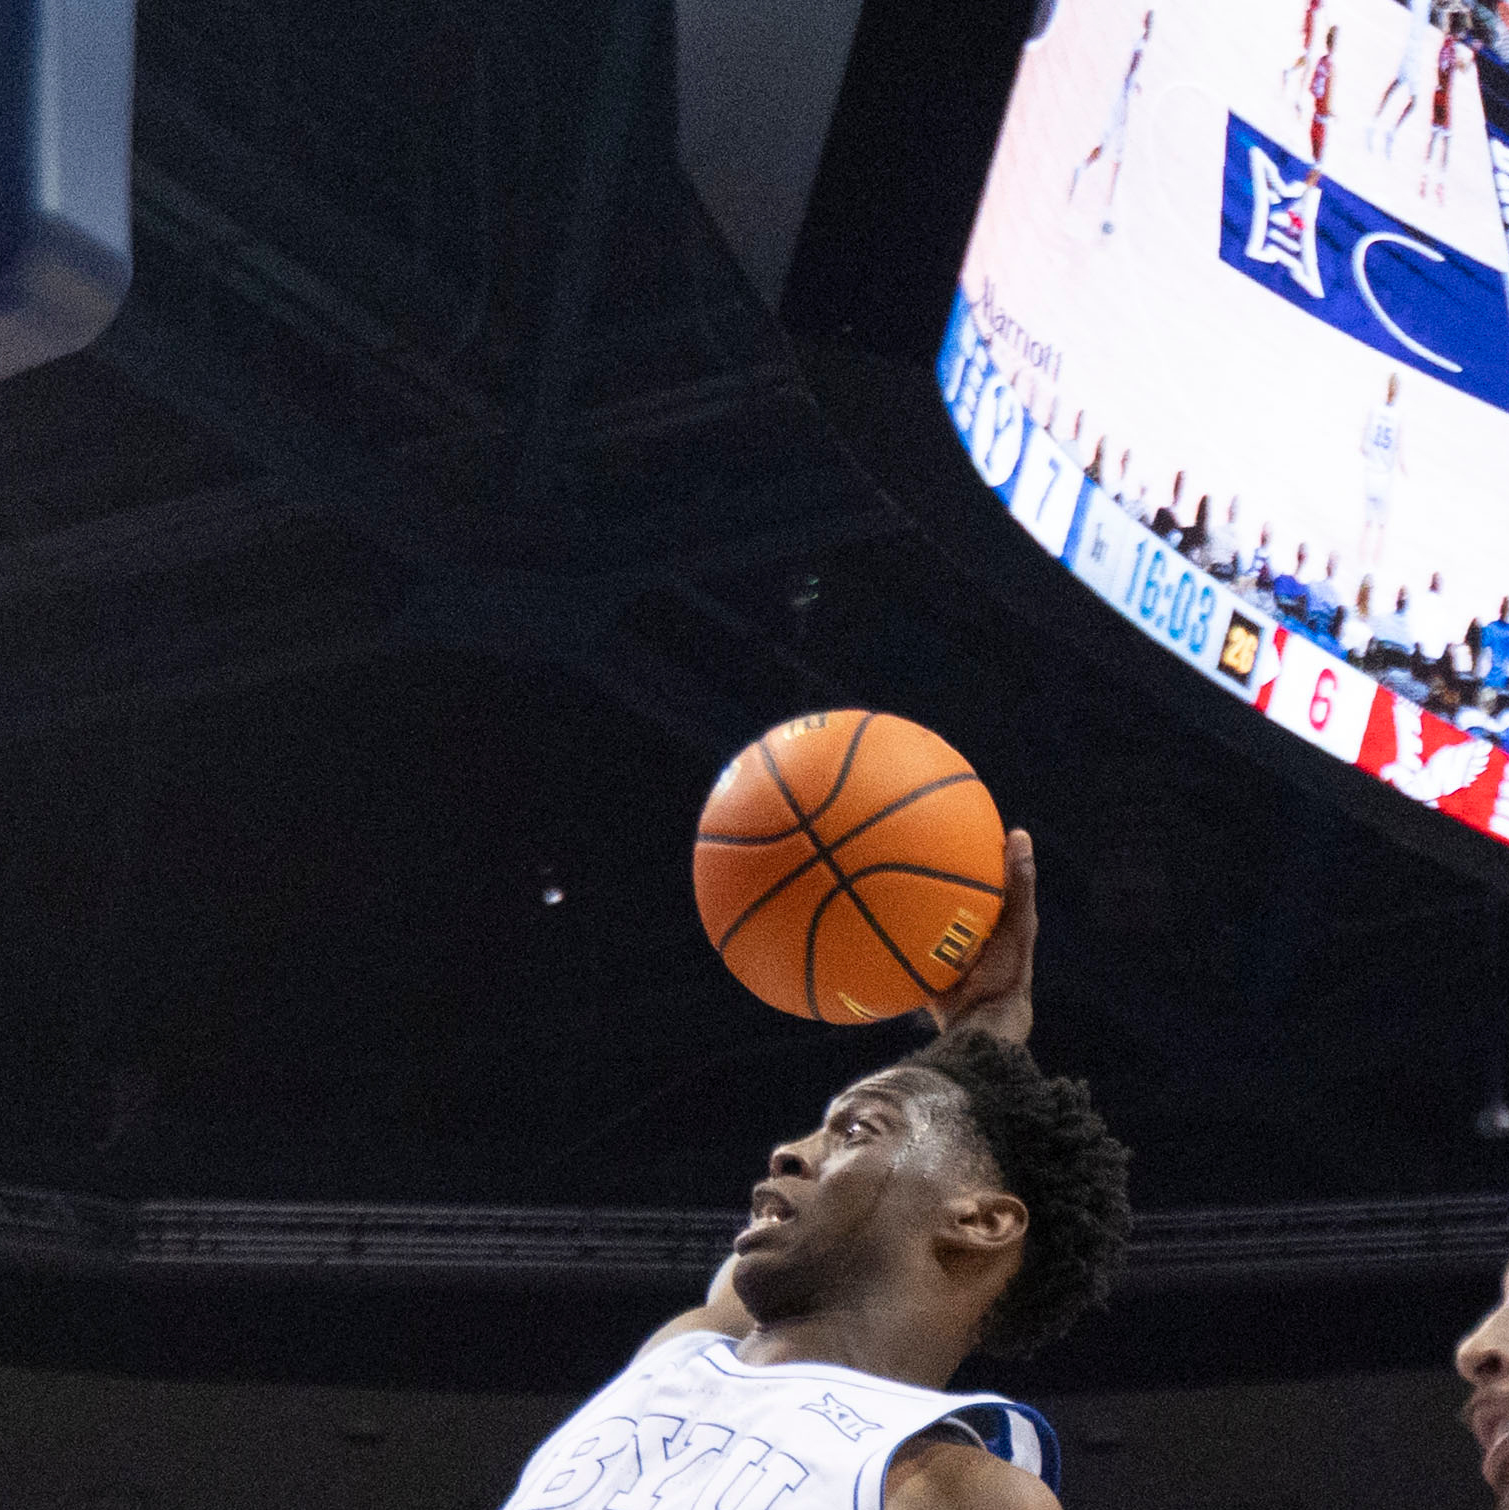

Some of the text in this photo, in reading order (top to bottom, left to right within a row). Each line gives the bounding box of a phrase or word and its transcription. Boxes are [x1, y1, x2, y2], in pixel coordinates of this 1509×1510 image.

[1036, 457, 1064, 522] 7
[1126, 541, 1217, 655] 16:03
[1308, 668, 1338, 731] 6
